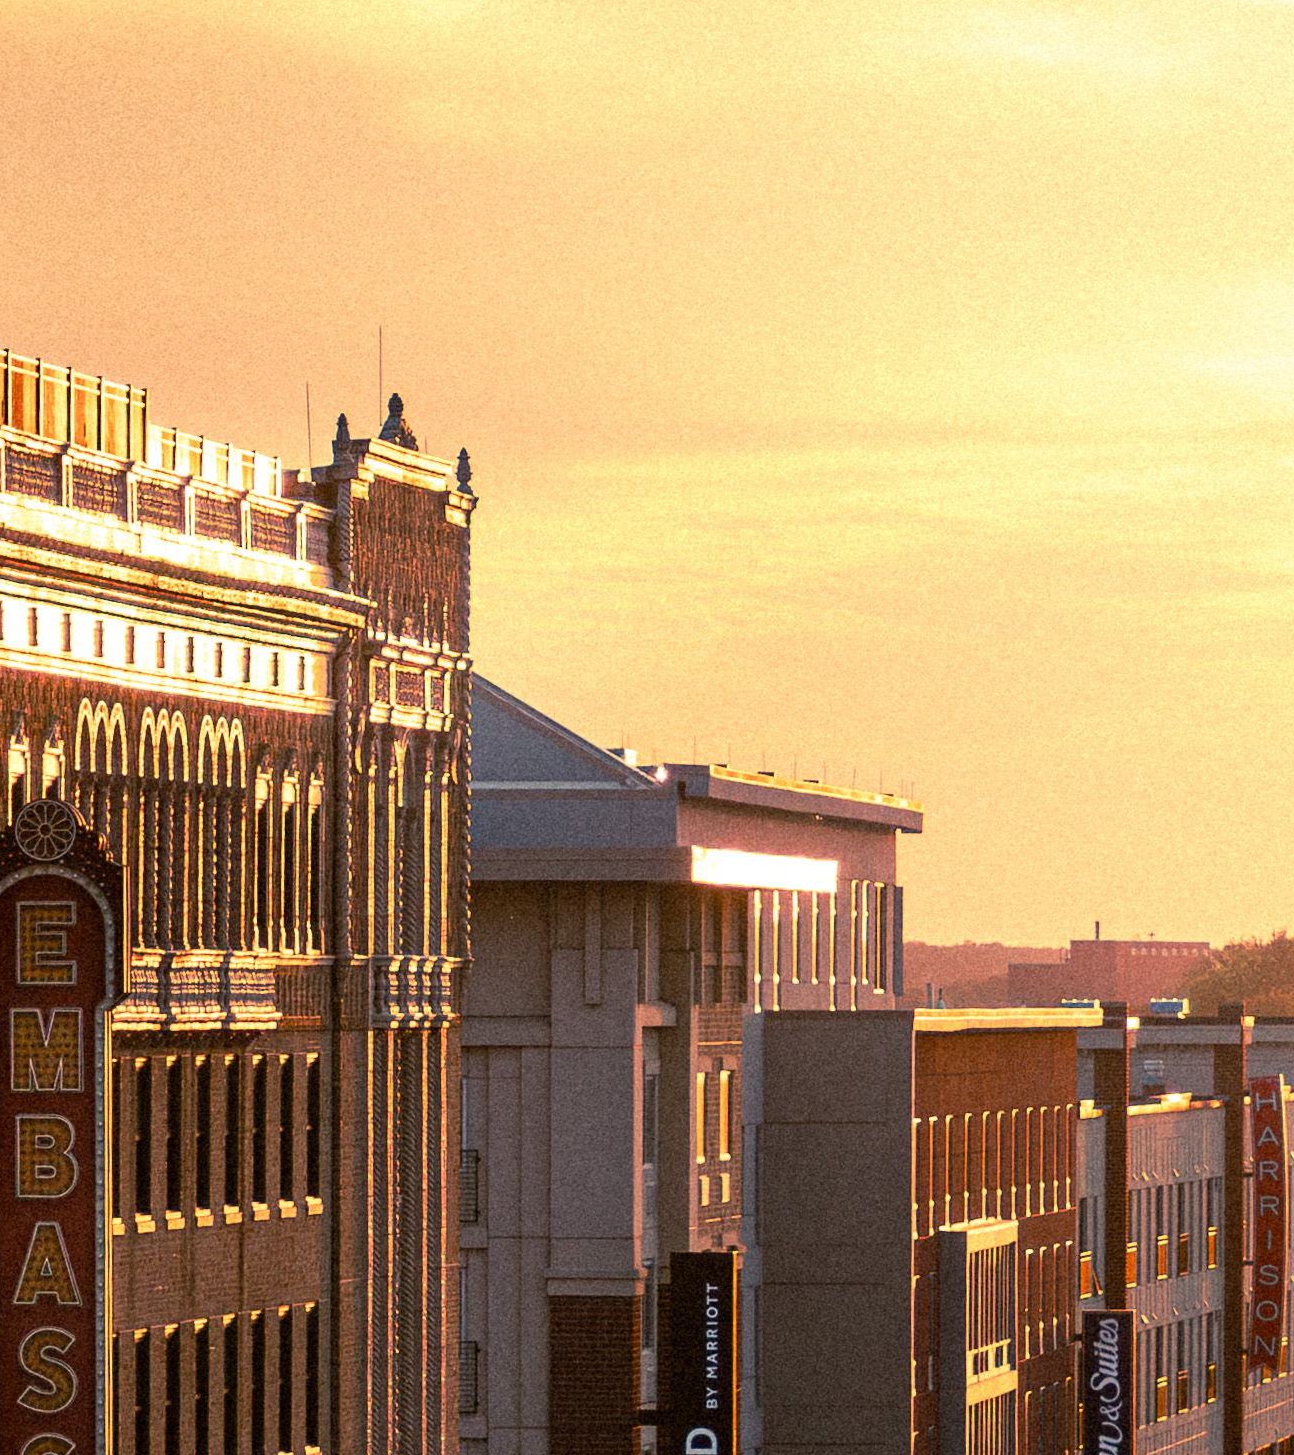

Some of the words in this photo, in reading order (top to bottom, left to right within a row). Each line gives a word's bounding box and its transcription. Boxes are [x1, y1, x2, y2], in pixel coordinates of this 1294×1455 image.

[1254, 1091, 1280, 1356] HARRISON
[705, 1282, 719, 1379] MARRIOTT
[1090, 1317, 1121, 1403] Suites
[705, 1386, 719, 1409] BY
